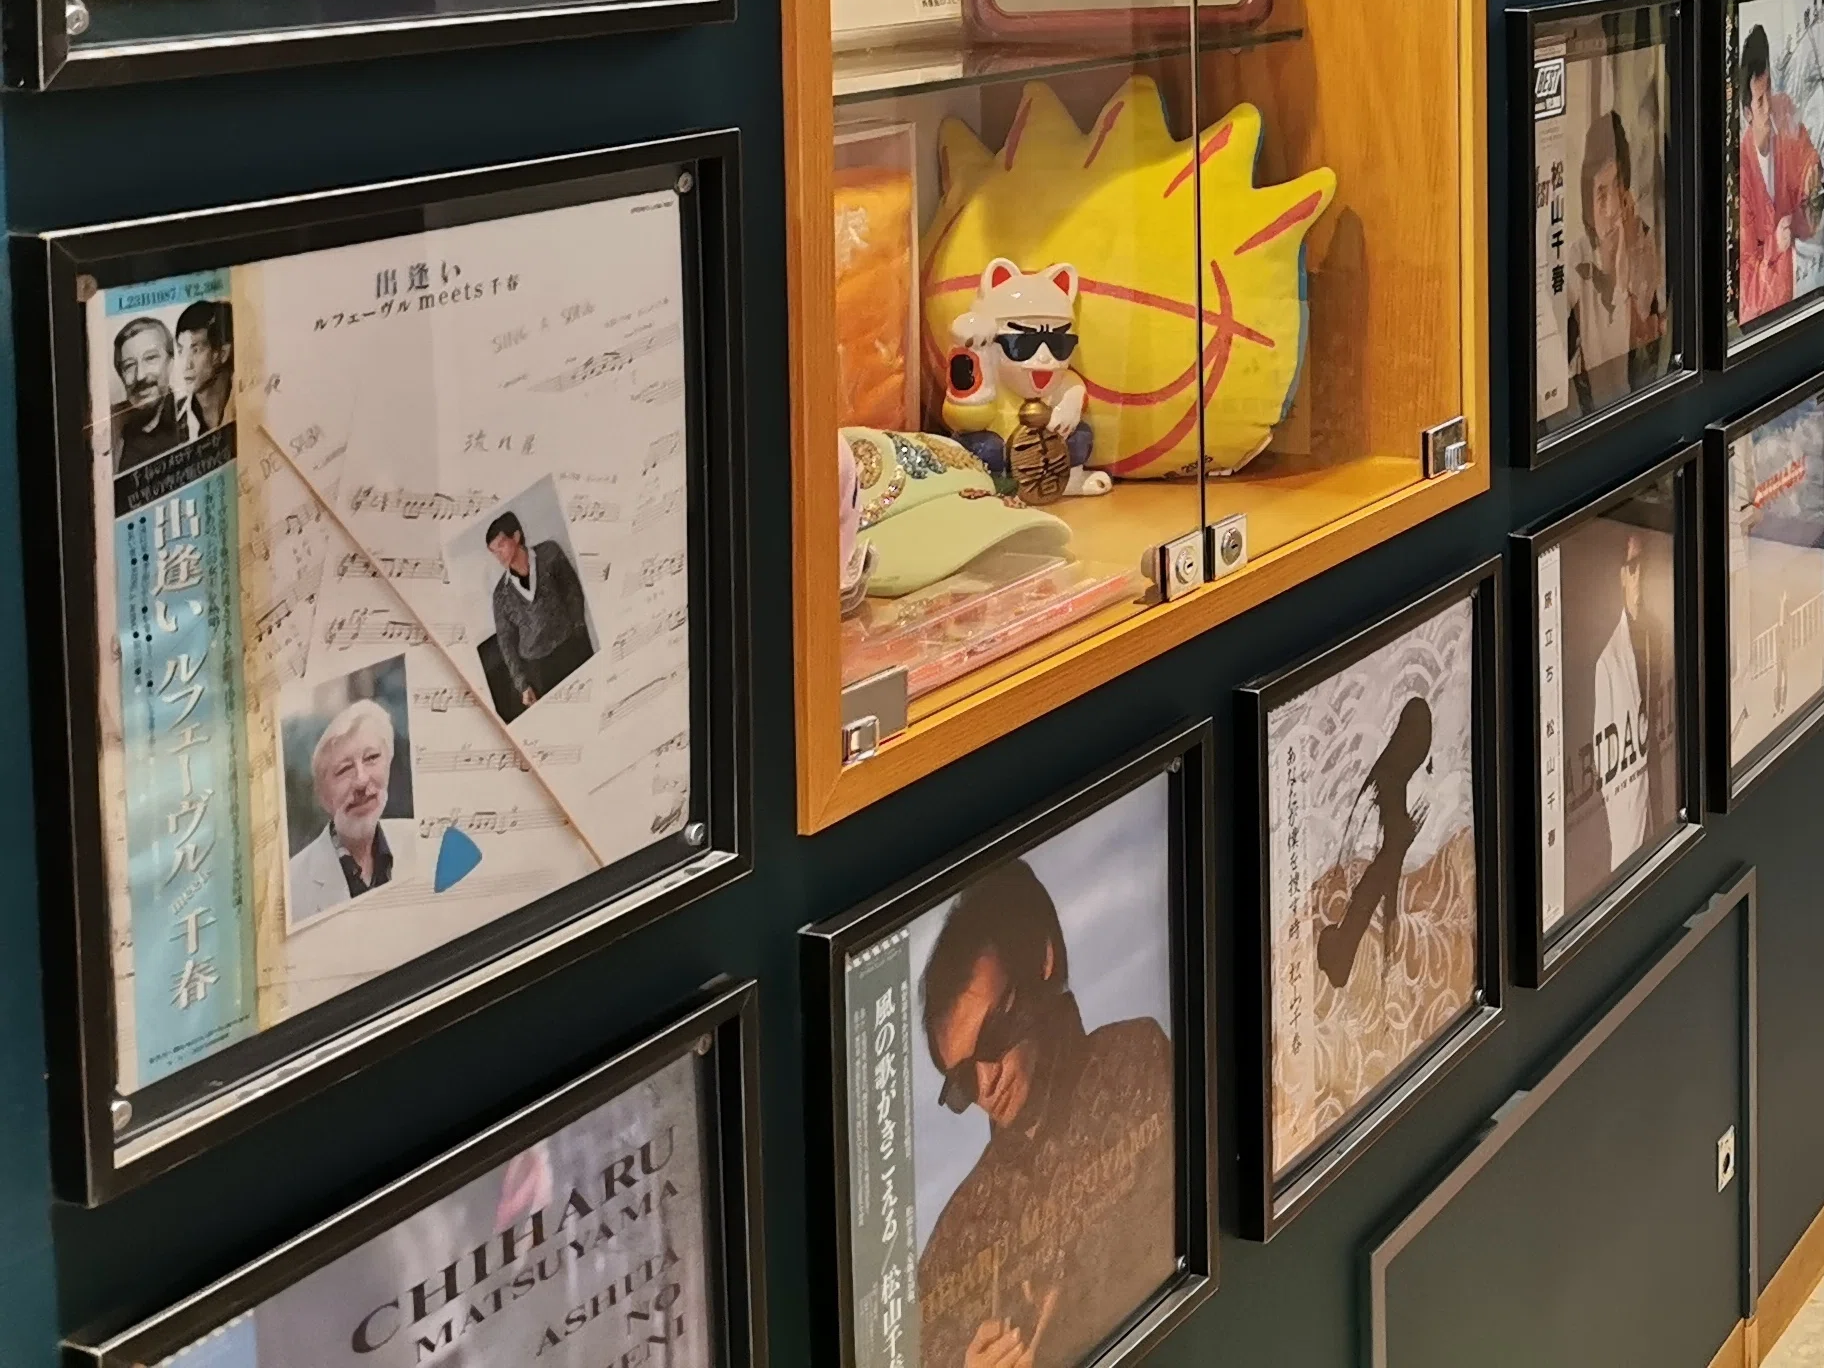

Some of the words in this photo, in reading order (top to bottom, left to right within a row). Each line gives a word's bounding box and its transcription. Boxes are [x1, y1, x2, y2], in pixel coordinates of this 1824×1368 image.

[1550, 159, 1564, 295] 松山千春
[418, 281, 484, 311] meets
[351, 1124, 677, 1354] CHIHARU
[415, 1178, 679, 1364] MATSUYAMA
[535, 1245, 681, 1358] ASHITA
[626, 1282, 682, 1336] NO
